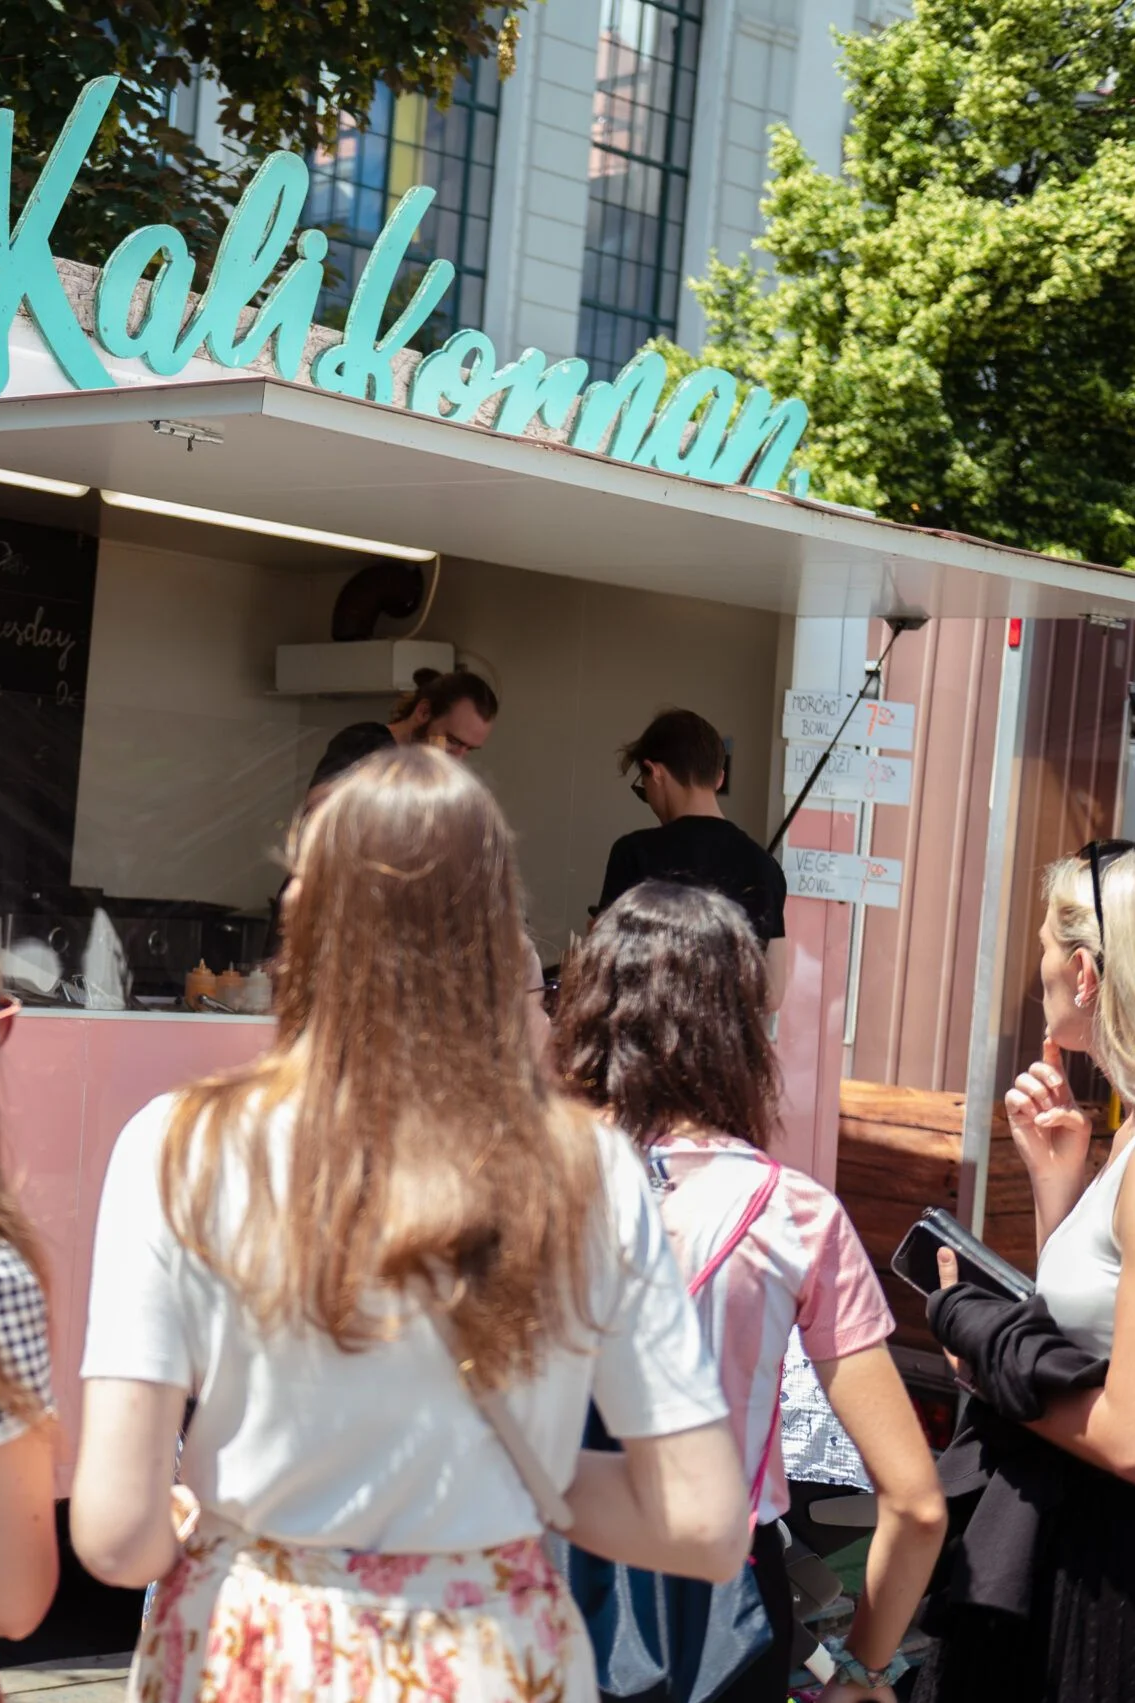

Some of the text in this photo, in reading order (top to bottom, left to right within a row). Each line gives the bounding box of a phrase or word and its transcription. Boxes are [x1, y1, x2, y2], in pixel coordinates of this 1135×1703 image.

[801, 719, 834, 737] BOWL
[804, 776, 836, 796] OWL
[796, 850, 838, 873] VEGE
[798, 875, 836, 894] BOWL
